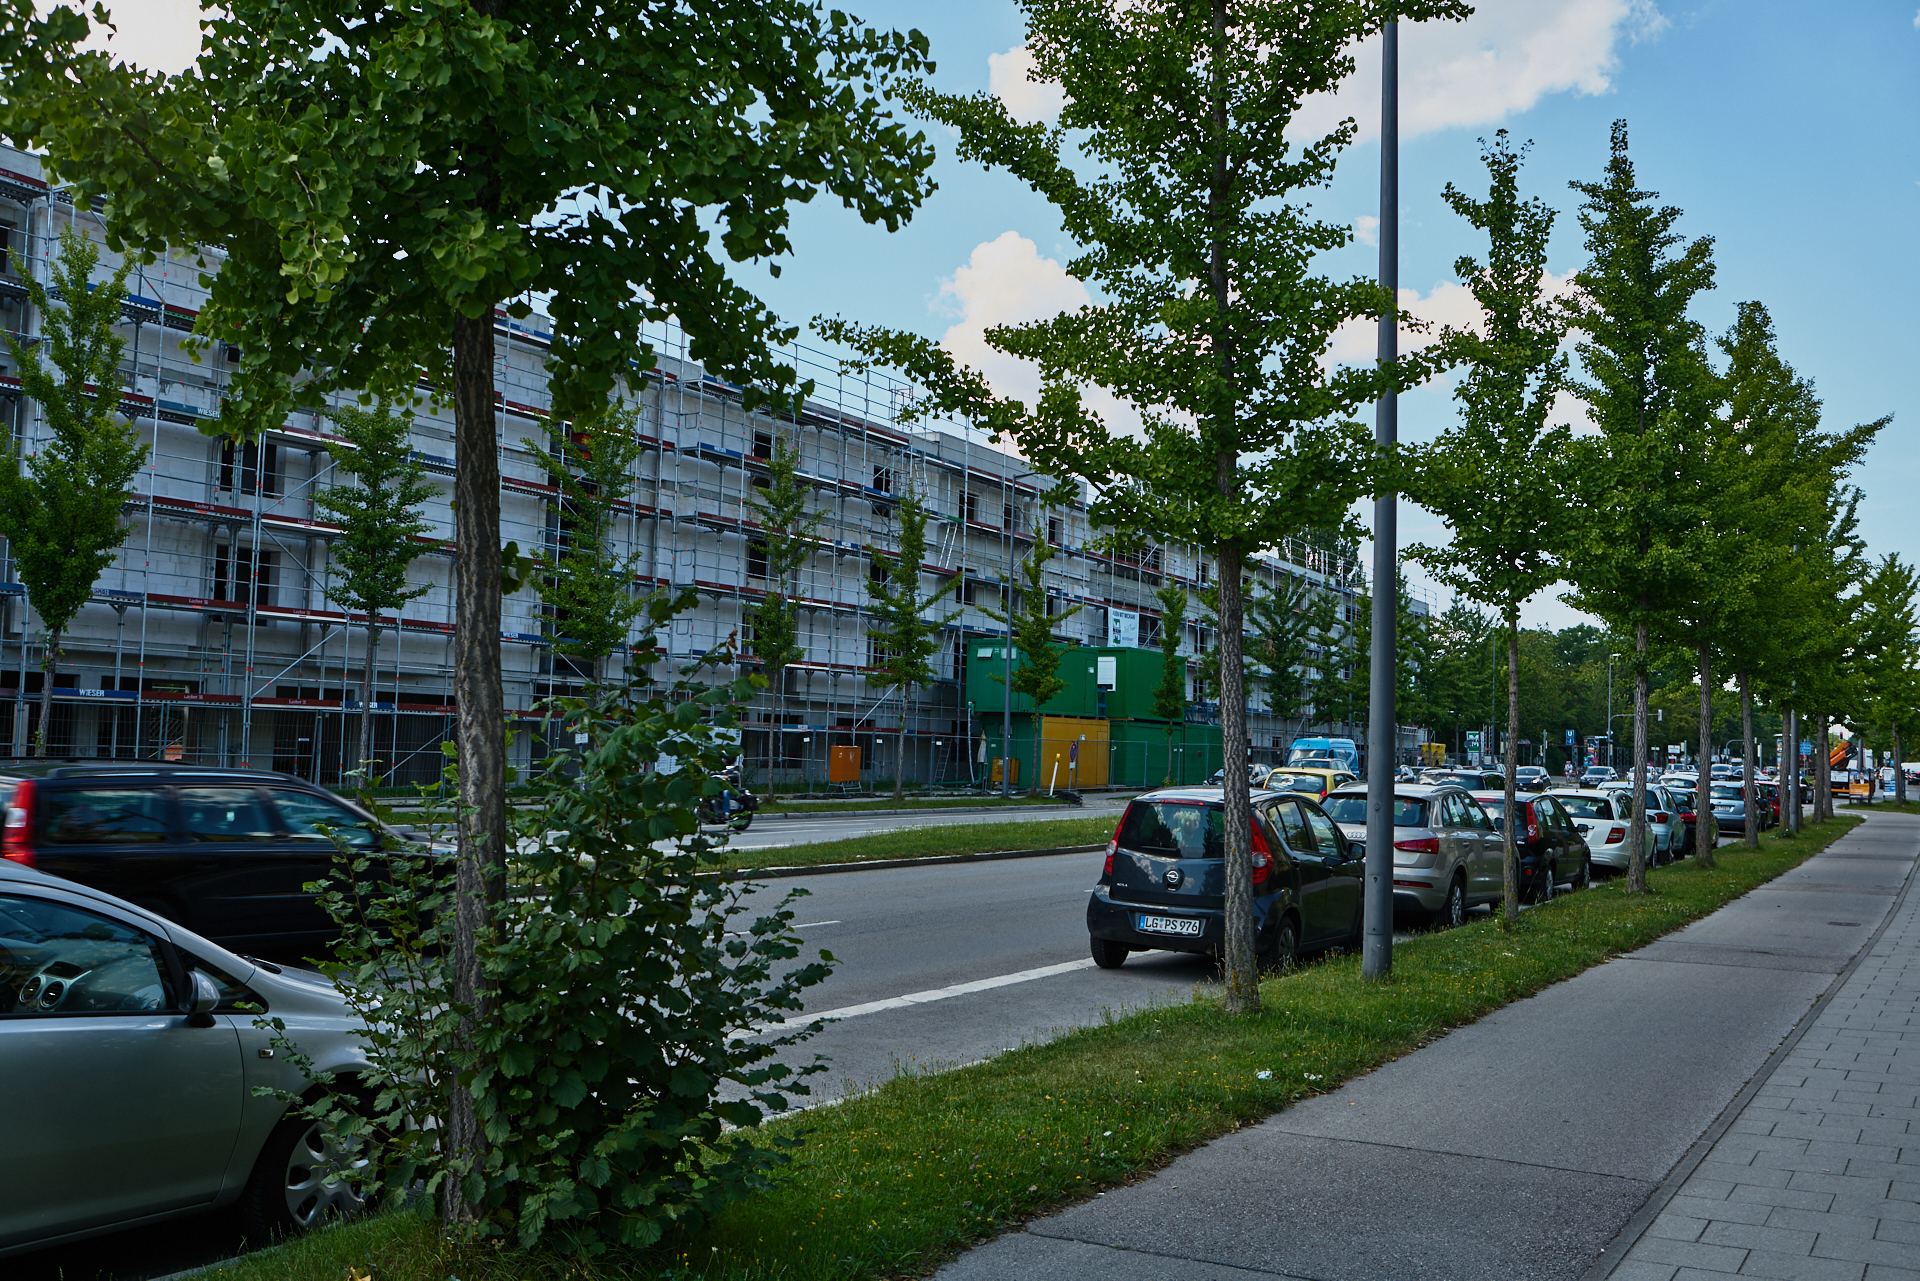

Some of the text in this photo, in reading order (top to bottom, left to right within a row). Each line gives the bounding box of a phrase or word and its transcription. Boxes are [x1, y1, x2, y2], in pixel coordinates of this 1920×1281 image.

[197, 407, 220, 418] WIESER
[79, 688, 105, 698] WIESER
[1145, 917, 1198, 932] LG PS 976
